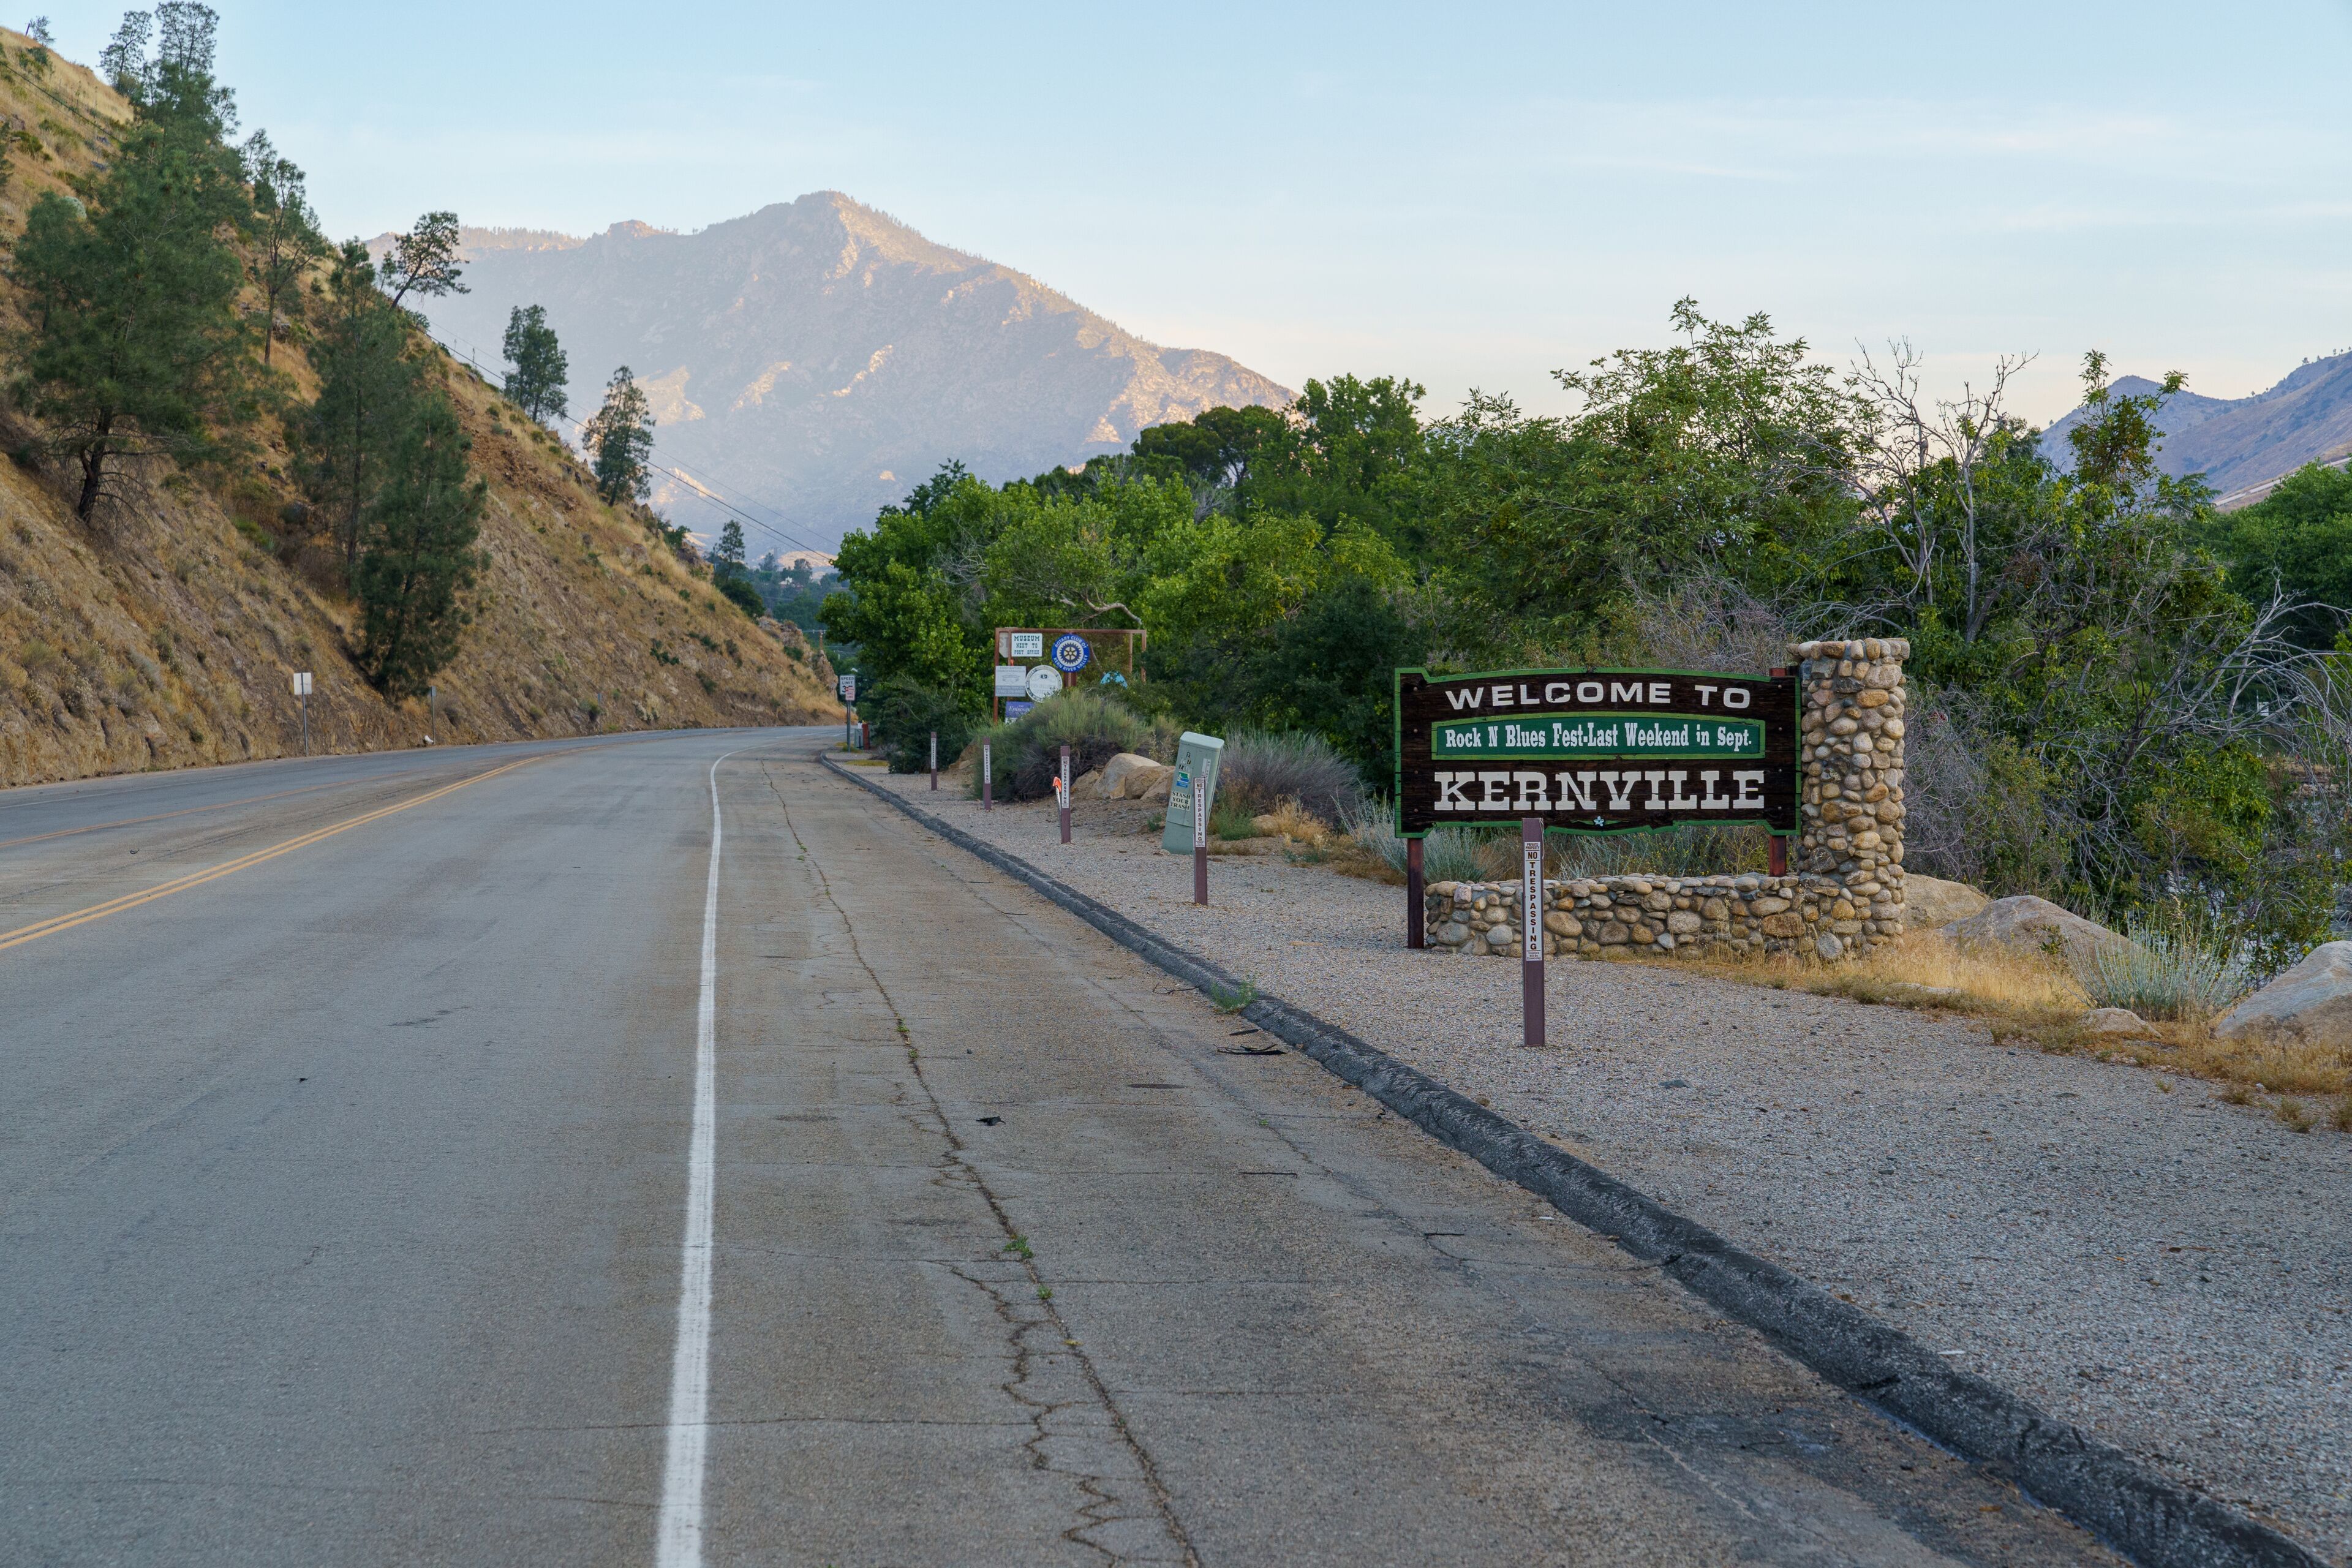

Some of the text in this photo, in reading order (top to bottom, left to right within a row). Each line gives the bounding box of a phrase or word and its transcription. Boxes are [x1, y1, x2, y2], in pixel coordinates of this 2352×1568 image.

[1054, 636, 1069, 647] ROTARY
[1054, 657, 1063, 668] KERN
[1076, 655, 1088, 669] VALLEY
[1445, 682, 1750, 710] WELCOME TO
[1446, 722, 1752, 752] Rock N Blues Fest-Last Weekend in Sept.
[1434, 770, 1765, 811] KERNVILLE
